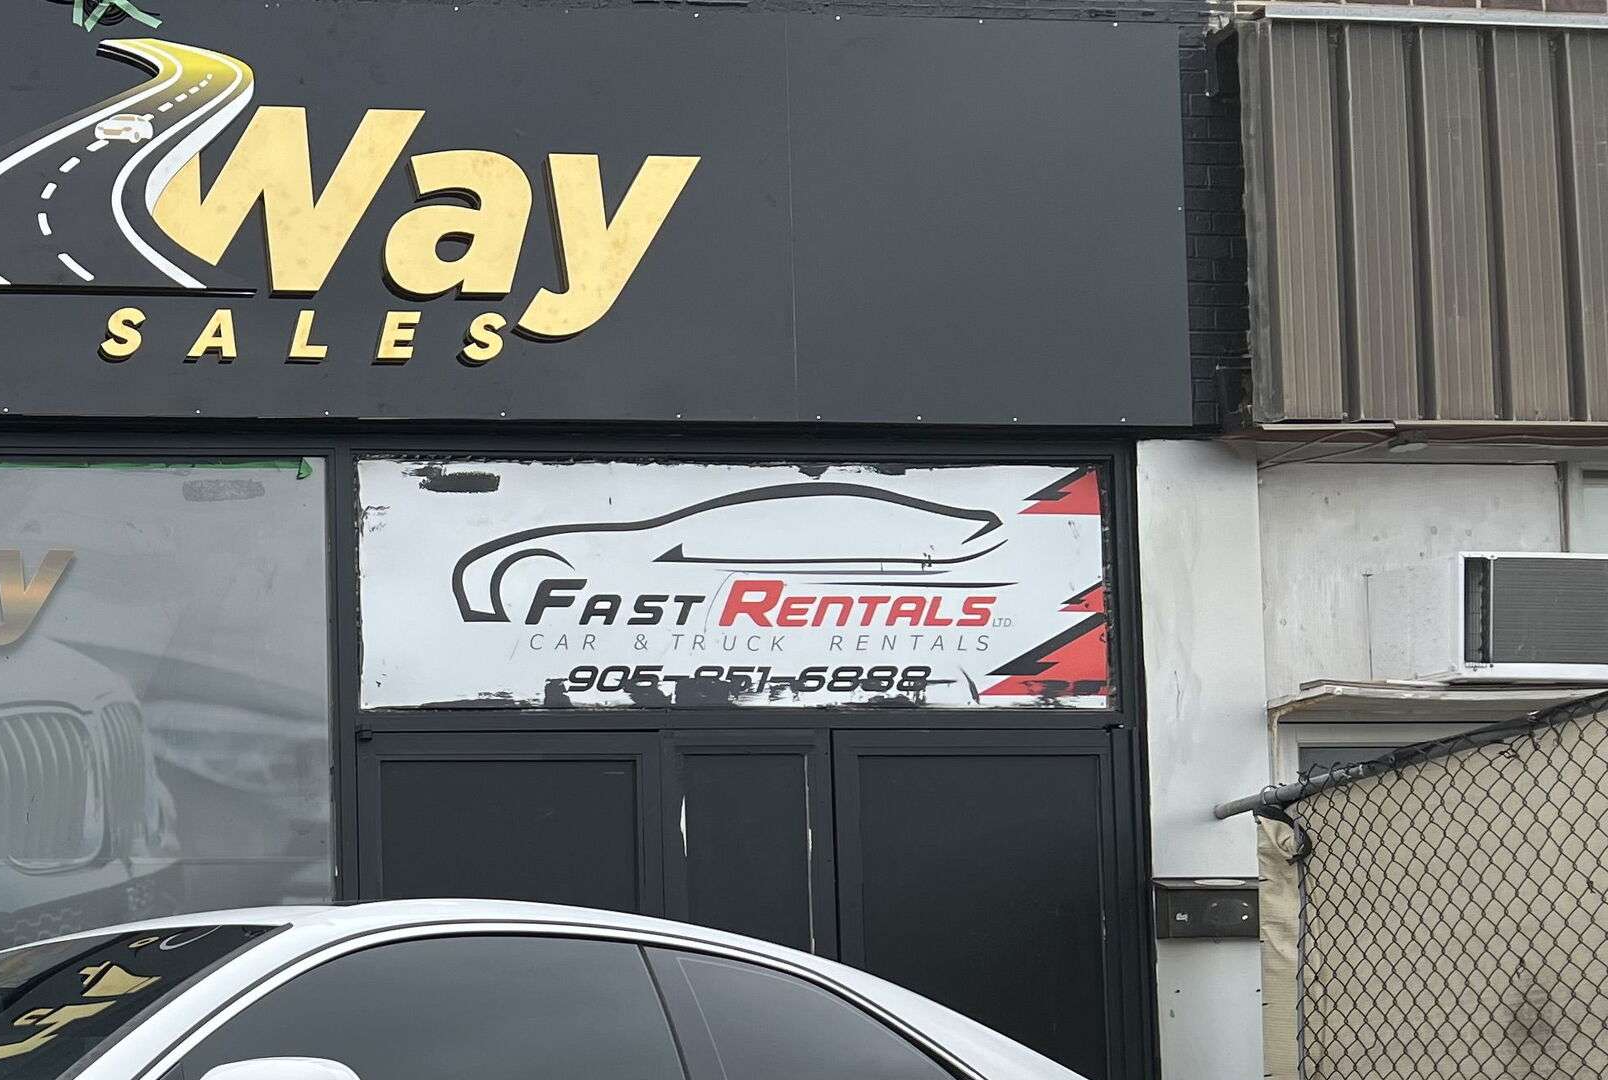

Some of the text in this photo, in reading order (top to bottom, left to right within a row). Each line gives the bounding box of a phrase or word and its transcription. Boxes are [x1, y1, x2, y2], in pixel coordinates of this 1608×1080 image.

[147, 105, 702, 340] Way
[99, 304, 508, 366] SALES
[529, 633, 991, 652] CAR & TRUCK RENTALS
